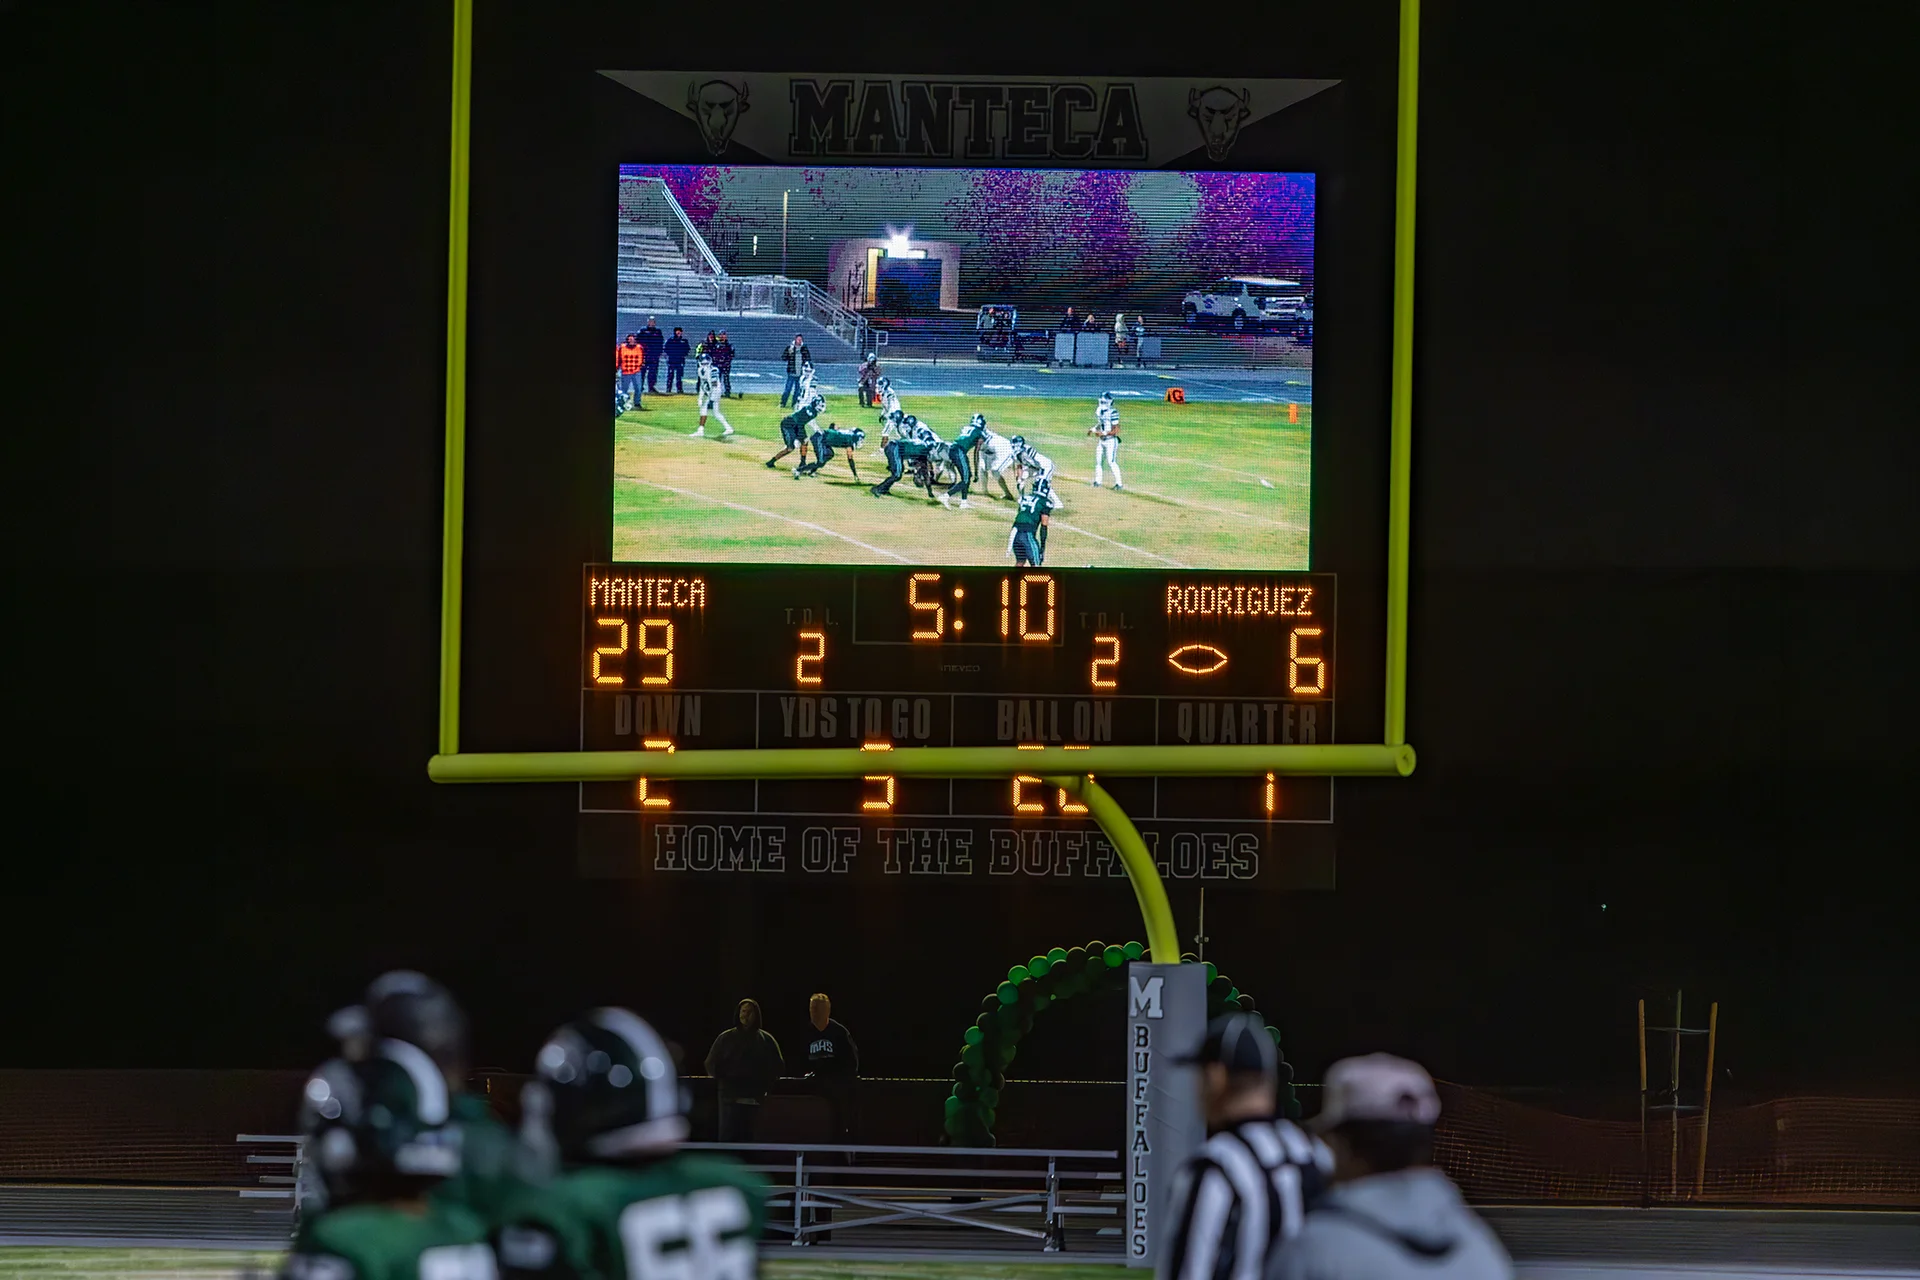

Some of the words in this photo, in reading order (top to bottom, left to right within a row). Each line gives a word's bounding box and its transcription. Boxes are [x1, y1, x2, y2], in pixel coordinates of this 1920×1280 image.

[789, 78, 1149, 160] MANTECA
[590, 577, 707, 608] MANTECA
[909, 573, 1055, 641] 5:10
[1166, 584, 1314, 617] RODRIGUEZ
[592, 618, 674, 685] 29
[796, 632, 825, 684] 2
[1091, 636, 1121, 688] 2
[1289, 627, 1325, 695] 6
[614, 694, 701, 736] DOWN
[780, 696, 838, 738] YDS
[847, 698, 882, 739] TO
[891, 698, 932, 740] GO
[997, 700, 1062, 741] BALL
[1073, 701, 1112, 742] ON
[1176, 702, 1318, 744] QUARTER
[654, 824, 786, 872] HOME
[801, 826, 861, 873] OF
[877, 828, 974, 875] THE
[1129, 976, 1164, 1019] M
[1132, 1022, 1151, 1259] BUFFALOES
